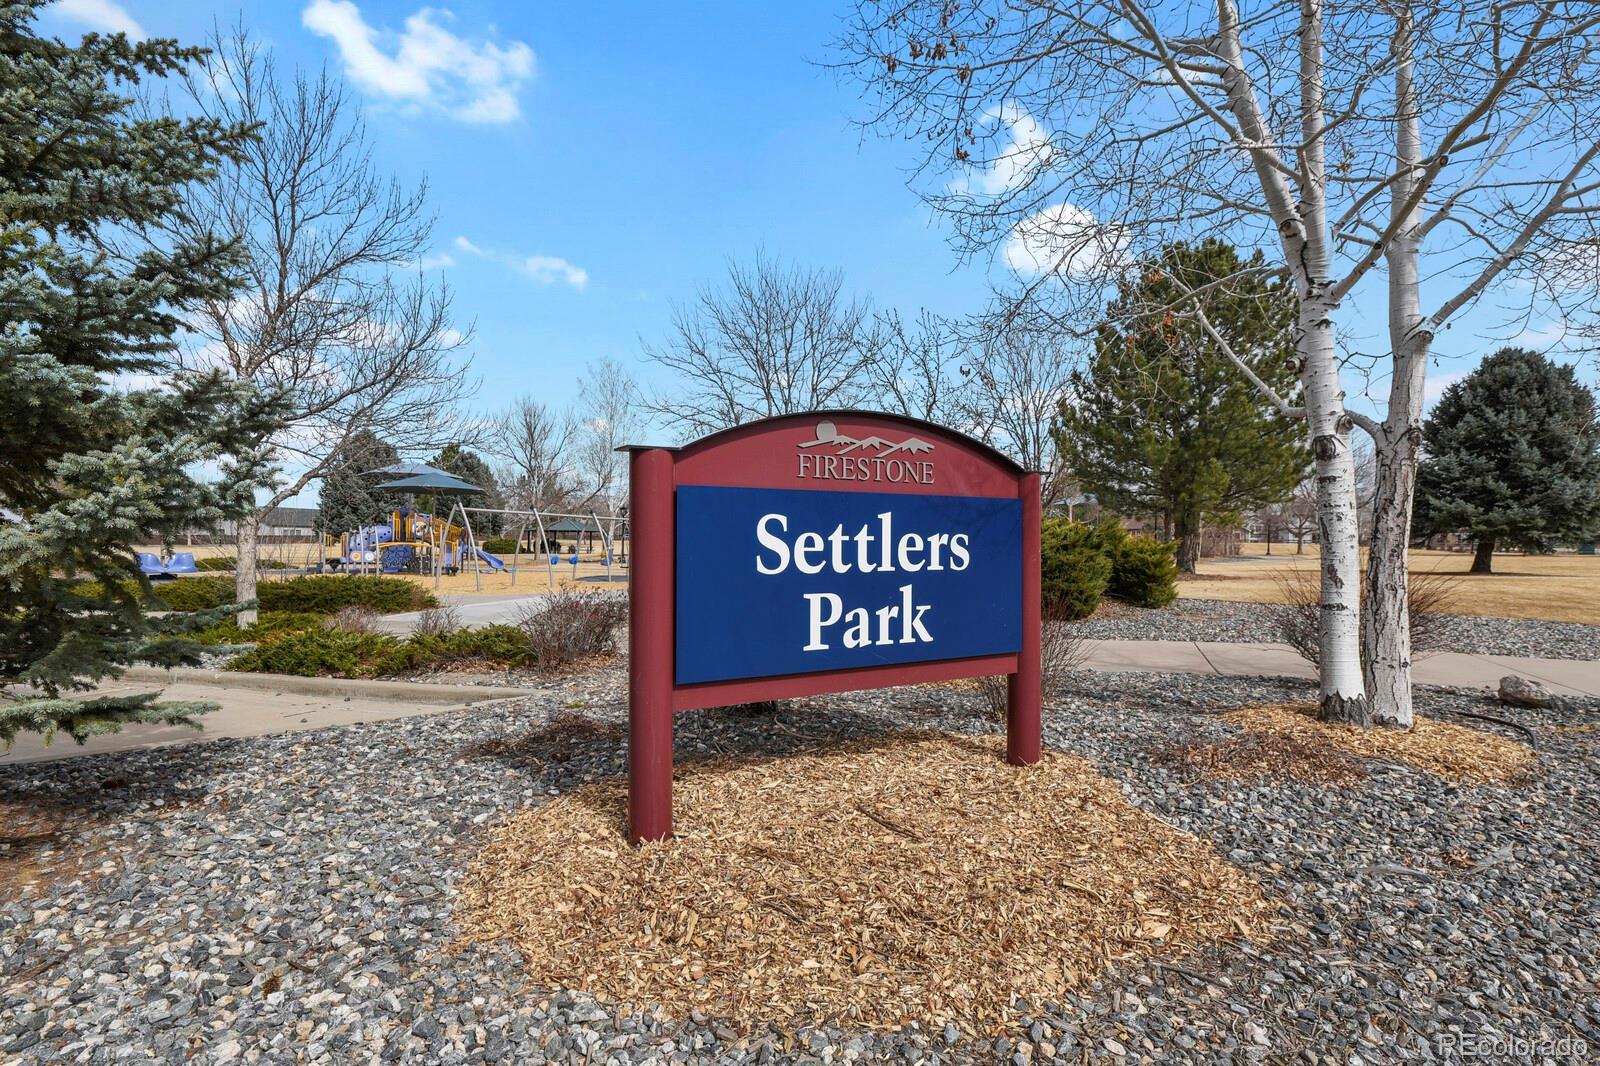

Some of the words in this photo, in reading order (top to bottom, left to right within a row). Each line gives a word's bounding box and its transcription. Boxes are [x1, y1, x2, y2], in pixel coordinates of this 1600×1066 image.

[797, 453, 935, 484] FIRESTONE
[756, 511, 970, 575] Settlers
[803, 584, 934, 652] Park
